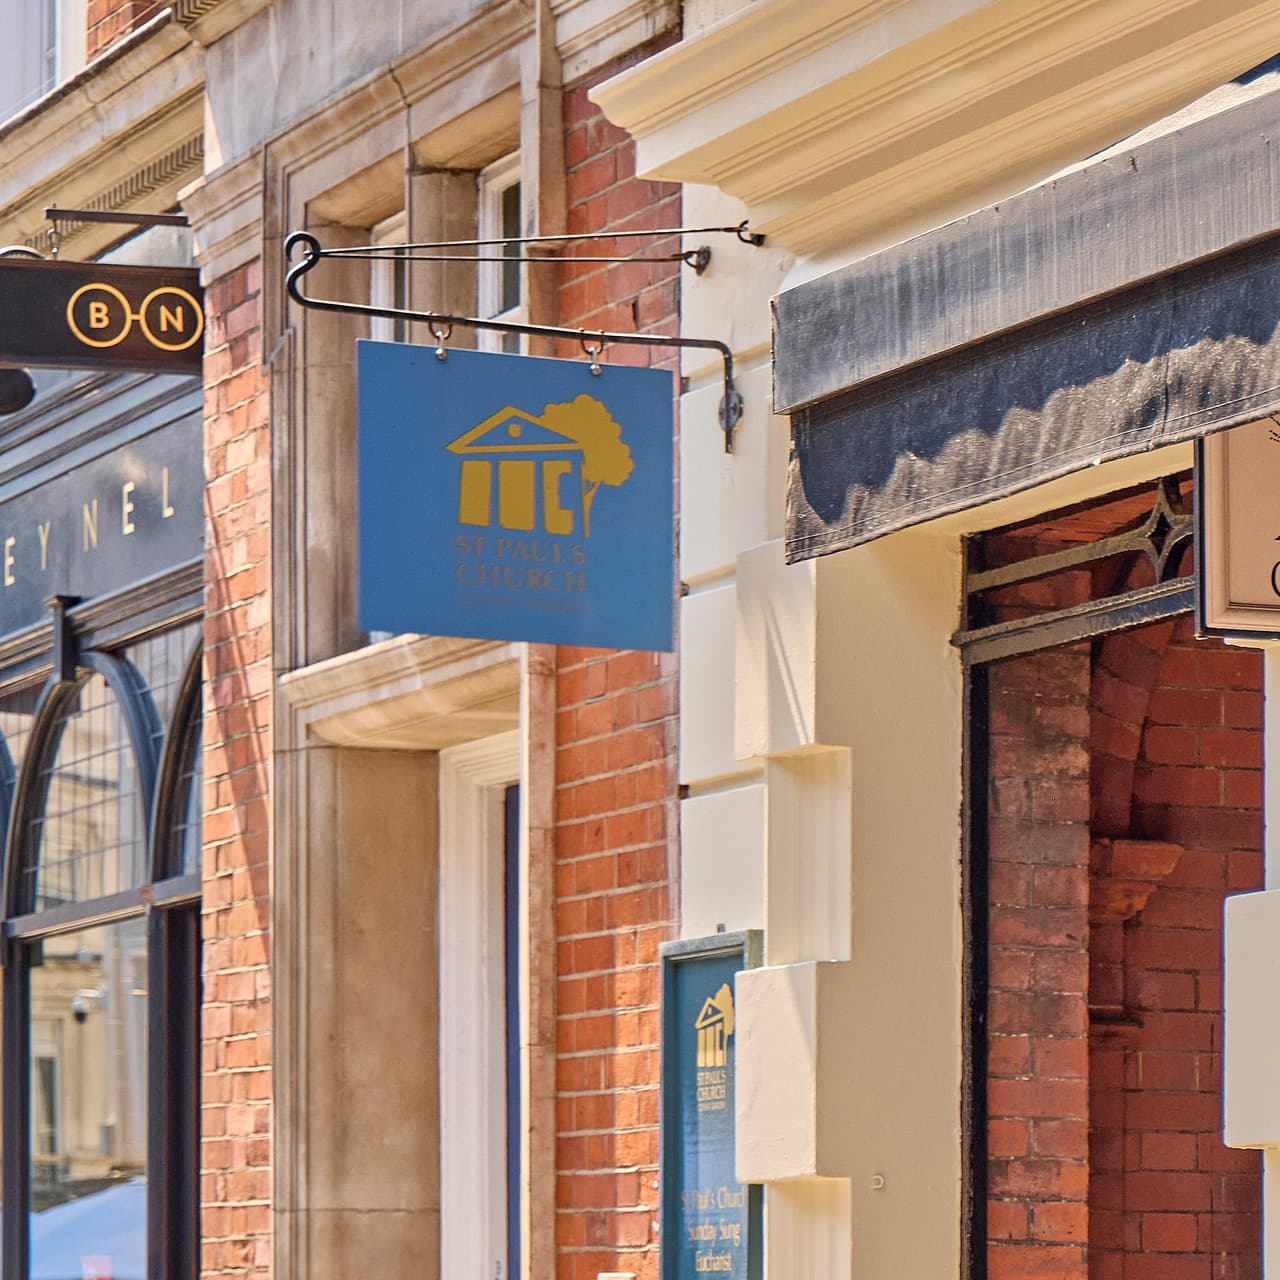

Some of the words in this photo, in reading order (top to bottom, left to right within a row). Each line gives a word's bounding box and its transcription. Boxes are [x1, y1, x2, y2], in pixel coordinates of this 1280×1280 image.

[89, 301, 110, 329] B
[159, 304, 184, 333] N
[4, 466, 175, 587] EYNEL
[455, 535, 486, 558] ST
[455, 561, 586, 593] CHURCH
[697, 1085, 726, 1102] CHURCH
[688, 1218, 717, 1248] Sunday
[719, 1217, 741, 1248] Sung
[695, 1249, 733, 1272] Eucharist
